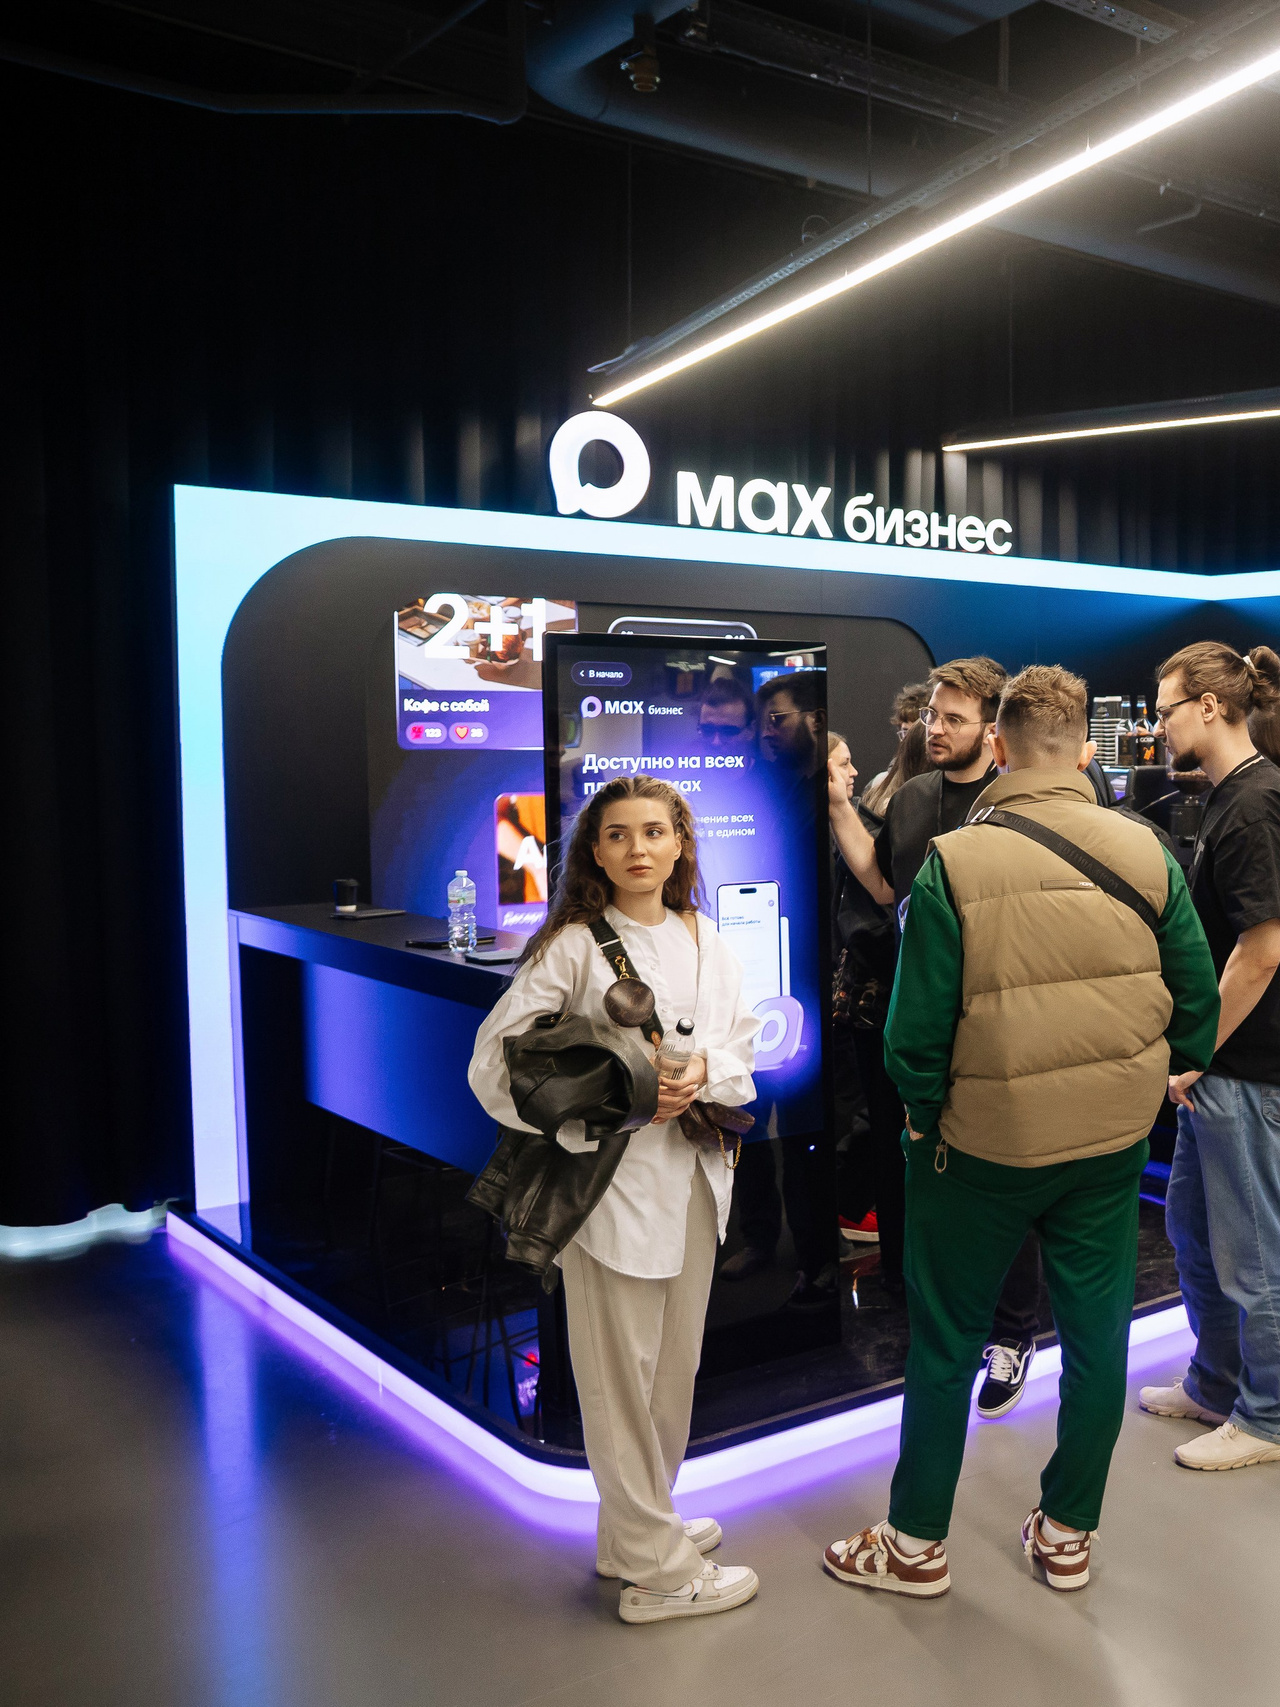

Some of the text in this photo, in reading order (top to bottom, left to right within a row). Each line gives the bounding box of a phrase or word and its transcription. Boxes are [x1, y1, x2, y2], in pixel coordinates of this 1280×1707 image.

[844, 493, 1013, 555] бизнес
[423, 592, 547, 662] 2+1
[588, 669, 624, 679] В начало
[403, 698, 490, 714] Кофе с собой
[648, 705, 684, 715] бизнес
[582, 753, 745, 774] Доступно на всех
[731, 813, 755, 823] всех
[707, 829, 714, 837] в
[716, 827, 756, 838] едином
[1063, 1541, 1081, 1552] NIKE
